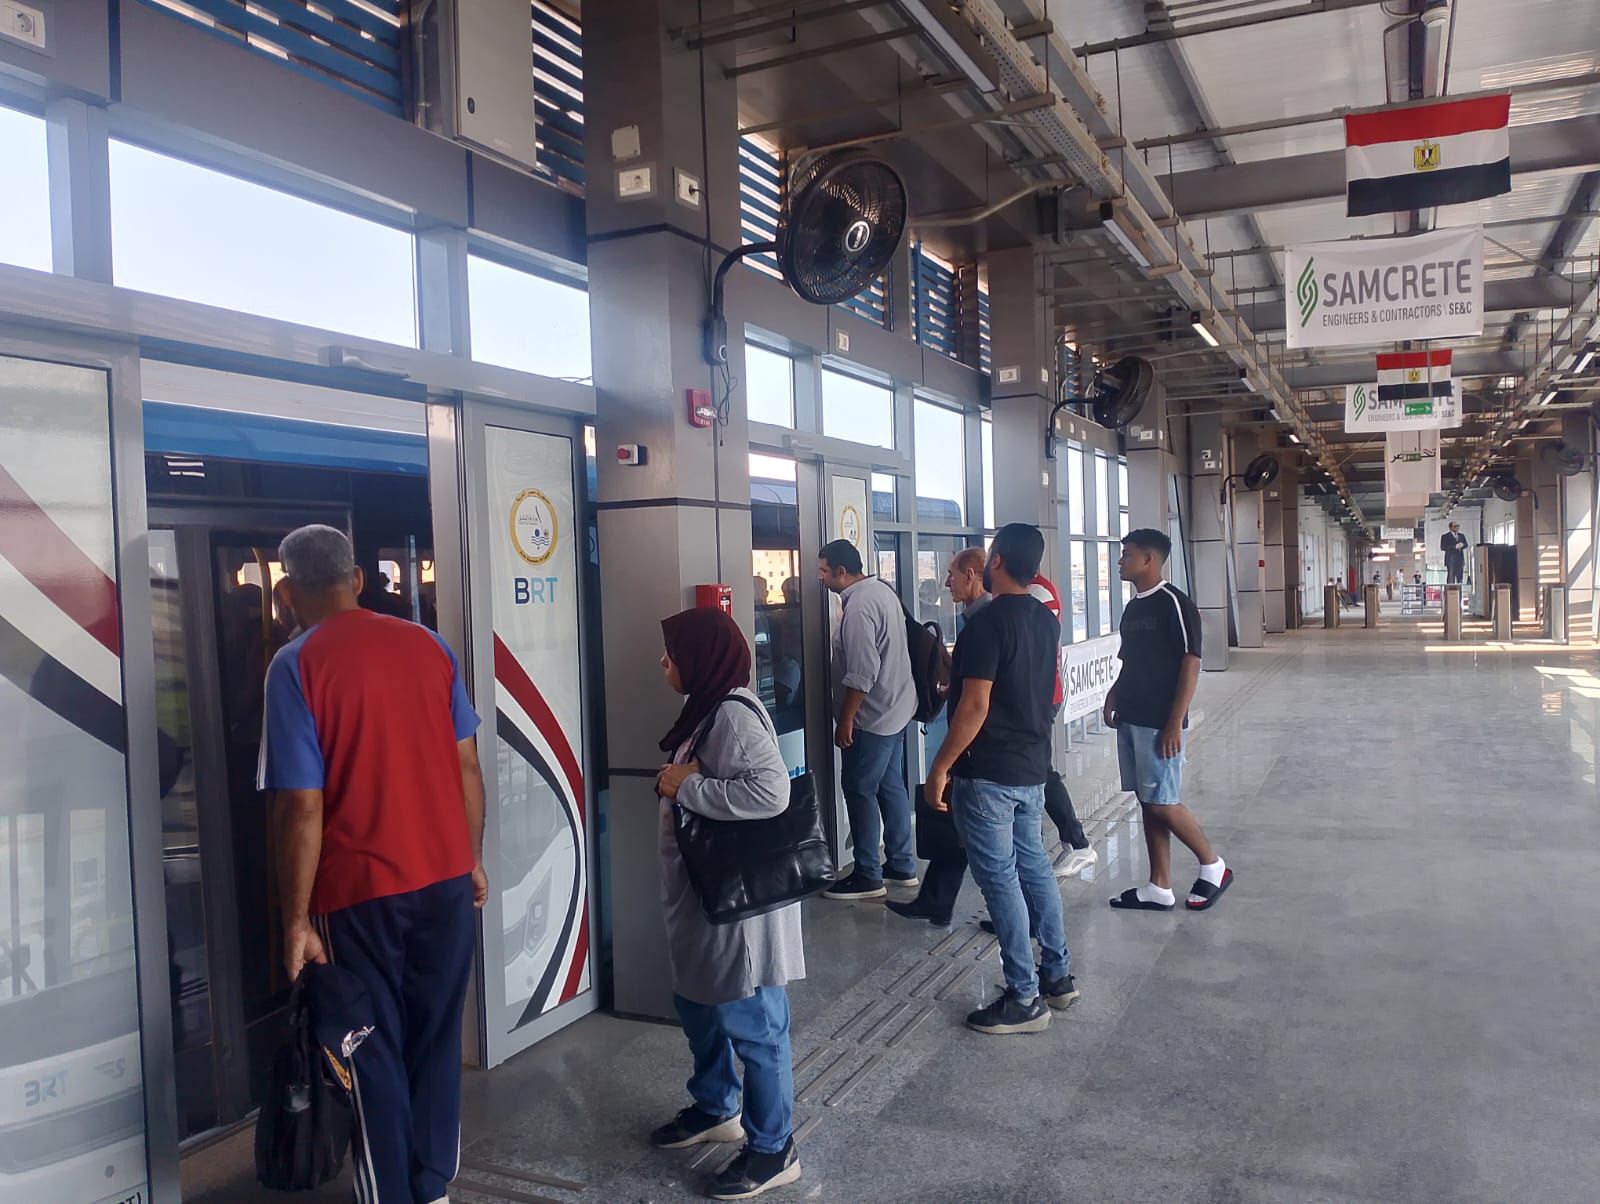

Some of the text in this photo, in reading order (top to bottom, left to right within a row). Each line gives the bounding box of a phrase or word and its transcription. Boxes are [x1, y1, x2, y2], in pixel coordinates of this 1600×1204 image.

[1323, 259, 1472, 307] SAMCRETE
[1322, 311, 1369, 327] ENGINEERS
[1371, 310, 1378, 323] &
[1380, 304, 1442, 322] CONTRACTORS
[1449, 301, 1472, 315] SE&C
[514, 577, 558, 604] BRT
